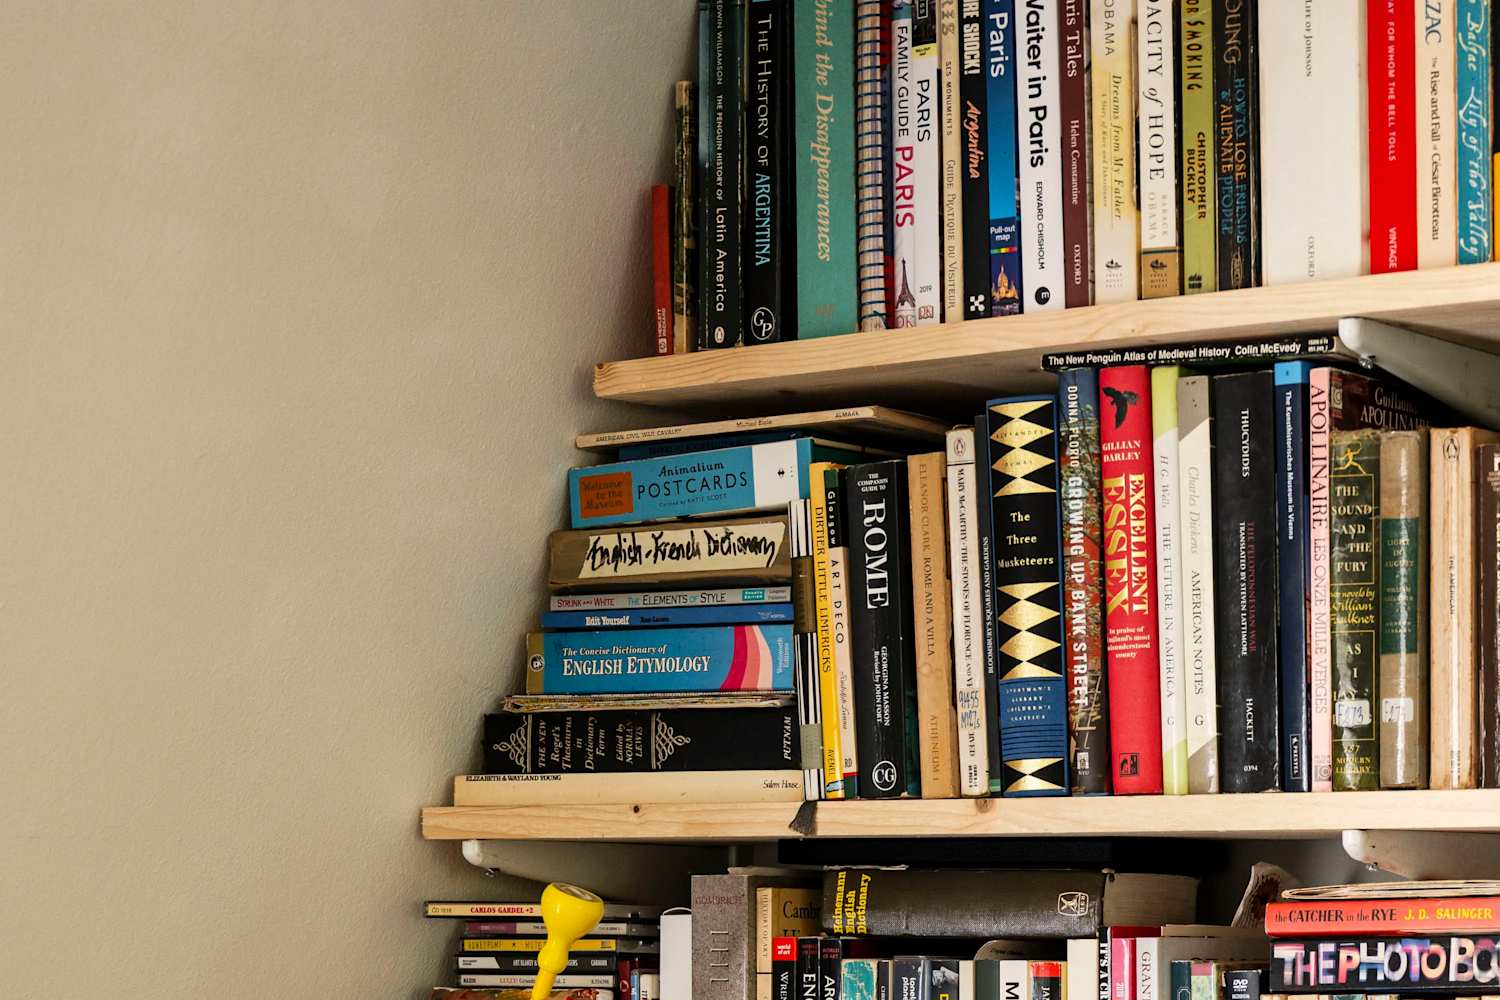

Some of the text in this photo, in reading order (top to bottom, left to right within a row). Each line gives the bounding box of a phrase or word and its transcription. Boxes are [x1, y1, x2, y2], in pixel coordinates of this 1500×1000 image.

[963, 22, 981, 76] SHOCK!
[988, 12, 1010, 79] Paris
[1066, 31, 1079, 78] Tales
[1186, 20, 1202, 91] SMOKING
[897, 25, 910, 138] FAMILY GUIDE
[917, 79, 931, 142] PARIS
[1028, 74, 1050, 168] in Paris
[716, 112, 724, 187] PENGUIN HISTORY
[755, 14, 772, 266] THE HISTORY OF ARGENTINA
[966, 99, 985, 180] Argentina
[1149, 114, 1166, 181] HOPE
[1219, 104, 1234, 174] ALIENATE
[810, 94, 835, 261] Disappearances
[895, 145, 915, 229] PARIS
[1186, 148, 1196, 204] BUCKLEY
[1197, 131, 1207, 220] CHRISTOPHER
[715, 207, 728, 312] Latin America
[1036, 220, 1044, 270] CHISHOLM
[1073, 244, 1082, 286] OXFORD
[1389, 227, 1398, 269] VINTAGE
[1048, 341, 1302, 367] The New Penguin Atlas Medieval History Colin McEvedy
[658, 460, 726, 478] Animalium
[1102, 440, 1142, 453] GILLIAN
[1103, 450, 1140, 463] DARLEY
[1240, 407, 1251, 480] THUCYDIDES
[1309, 384, 1328, 531] APOLLINAIRE
[636, 471, 748, 500] POSTCARDS
[1331, 503, 1372, 516] SOUND
[1335, 486, 1359, 497] THE
[1006, 534, 1038, 546] Three
[1009, 511, 1031, 523] The
[862, 498, 890, 611] ROME
[997, 555, 1055, 569] Musketeers
[1102, 474, 1130, 617] ESSEX
[1128, 472, 1149, 616] EXCELLENT
[1337, 561, 1367, 573] FURY
[642, 593, 688, 606] ELEMENTS
[700, 591, 727, 604] STYLE
[829, 559, 845, 645] ART DECO
[1067, 476, 1090, 707] GROWING BANK STREET
[562, 644, 657, 658] The Concise Dictionary
[562, 655, 712, 677] ENGLISH ETYMOLOGY
[781, 716, 792, 761] PUTNAM
[1245, 697, 1255, 743] HACKETT
[470, 906, 524, 914] CARLOS GARDEL
[832, 871, 848, 935] Heinemann
[845, 889, 857, 935] English
[856, 872, 873, 935] Dictionary
[1288, 907, 1398, 923] CATCHER RYE
[1436, 906, 1494, 921] SALINGER
